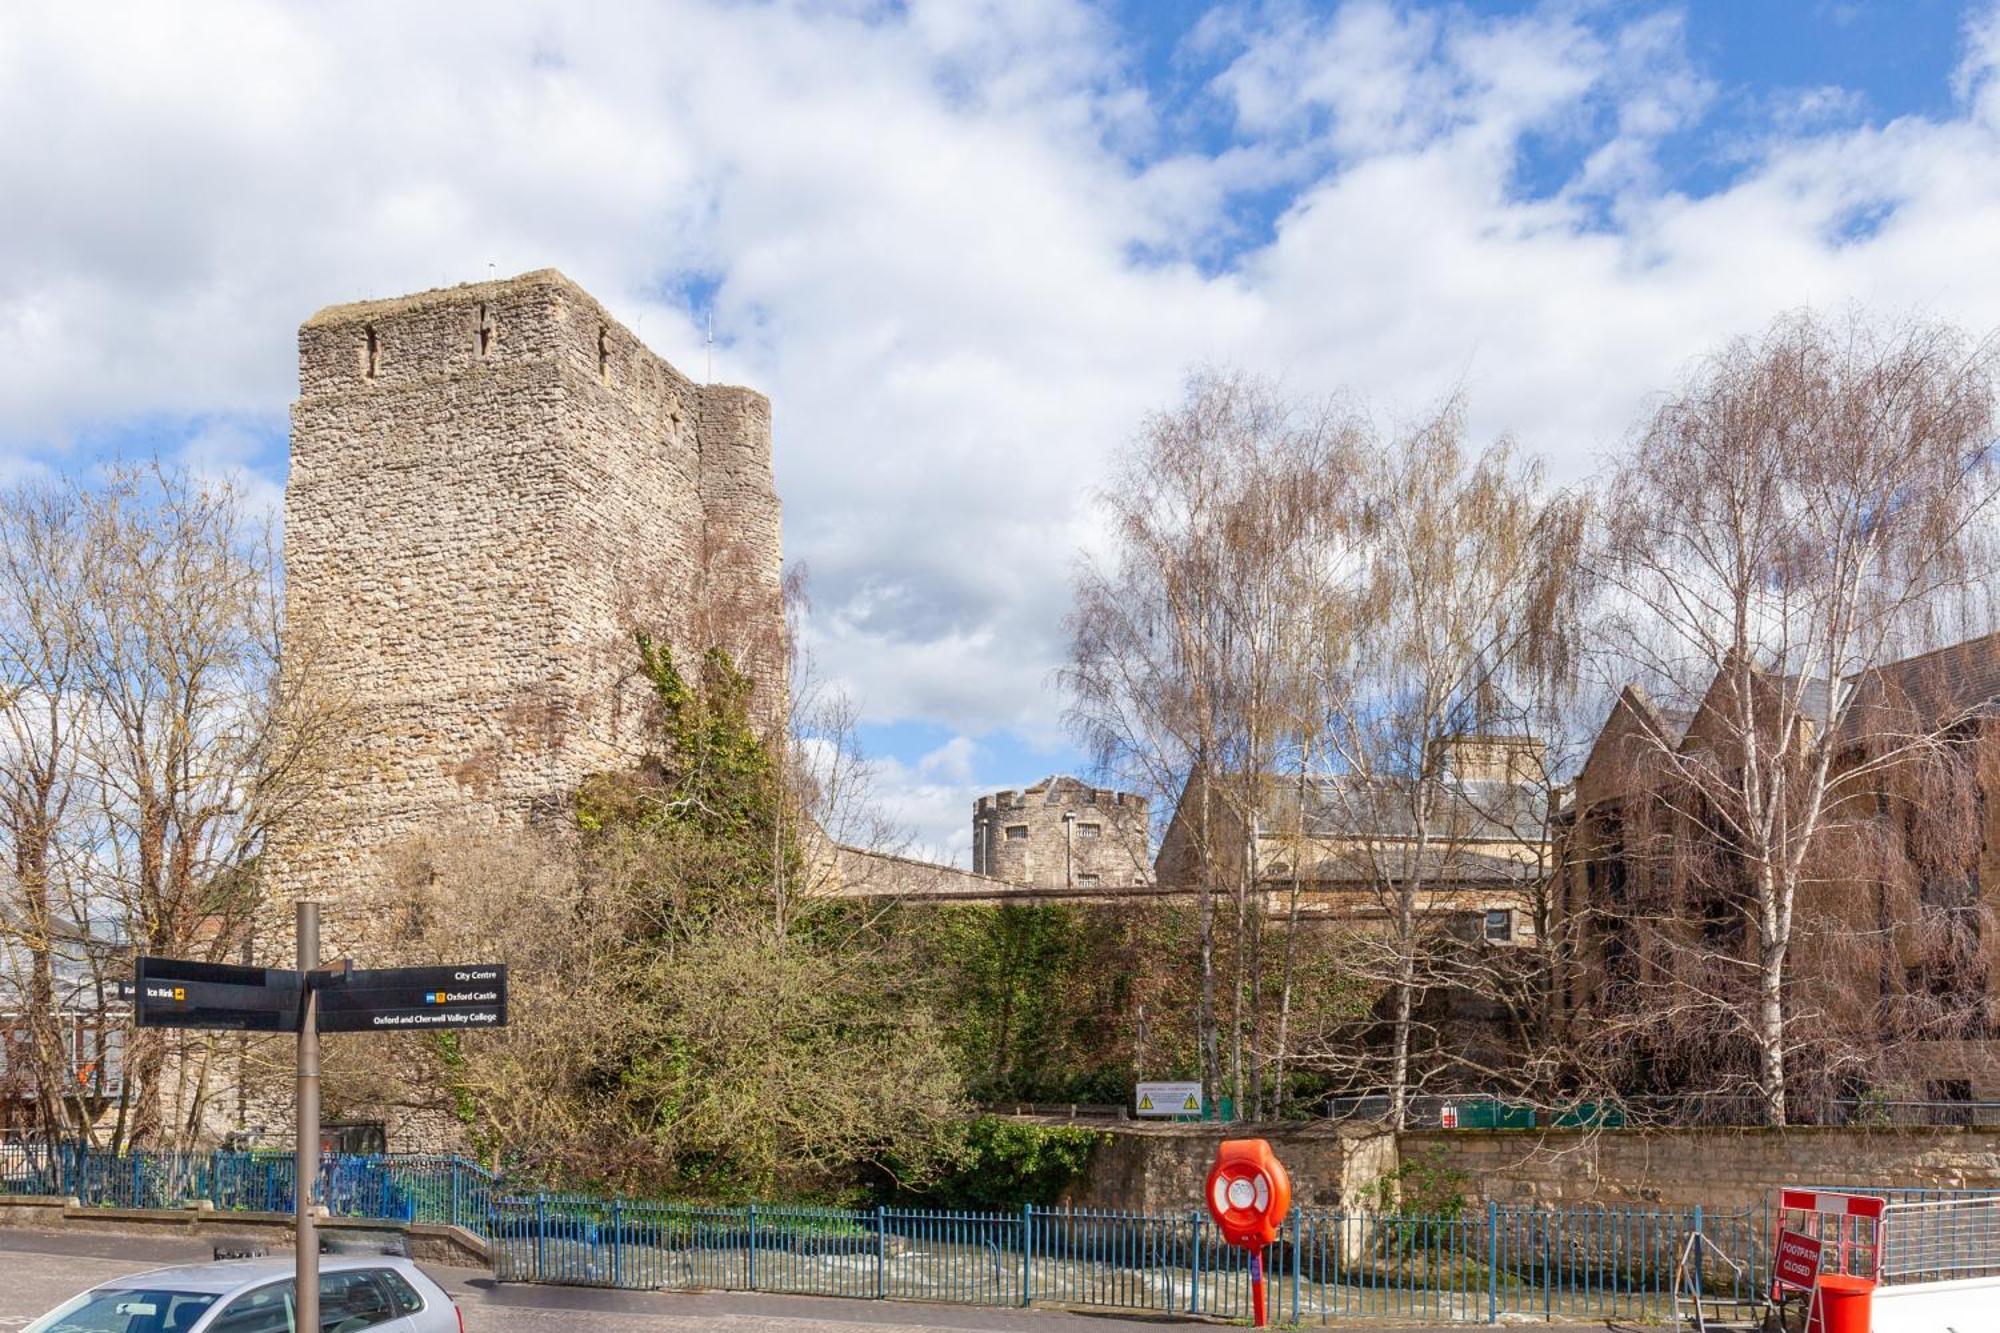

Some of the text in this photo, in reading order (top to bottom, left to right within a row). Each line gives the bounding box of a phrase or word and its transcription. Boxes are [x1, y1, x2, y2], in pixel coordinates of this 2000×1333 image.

[455, 971, 497, 981] City Centre
[147, 987, 173, 998] Ice Rink
[447, 992, 497, 1001] Oxford Castle
[373, 1013, 497, 1024] Oxford and Cherwell Valley College
[1782, 1241, 1818, 1262] FOOTPATH
[1784, 1260, 1810, 1277] CLOSED
